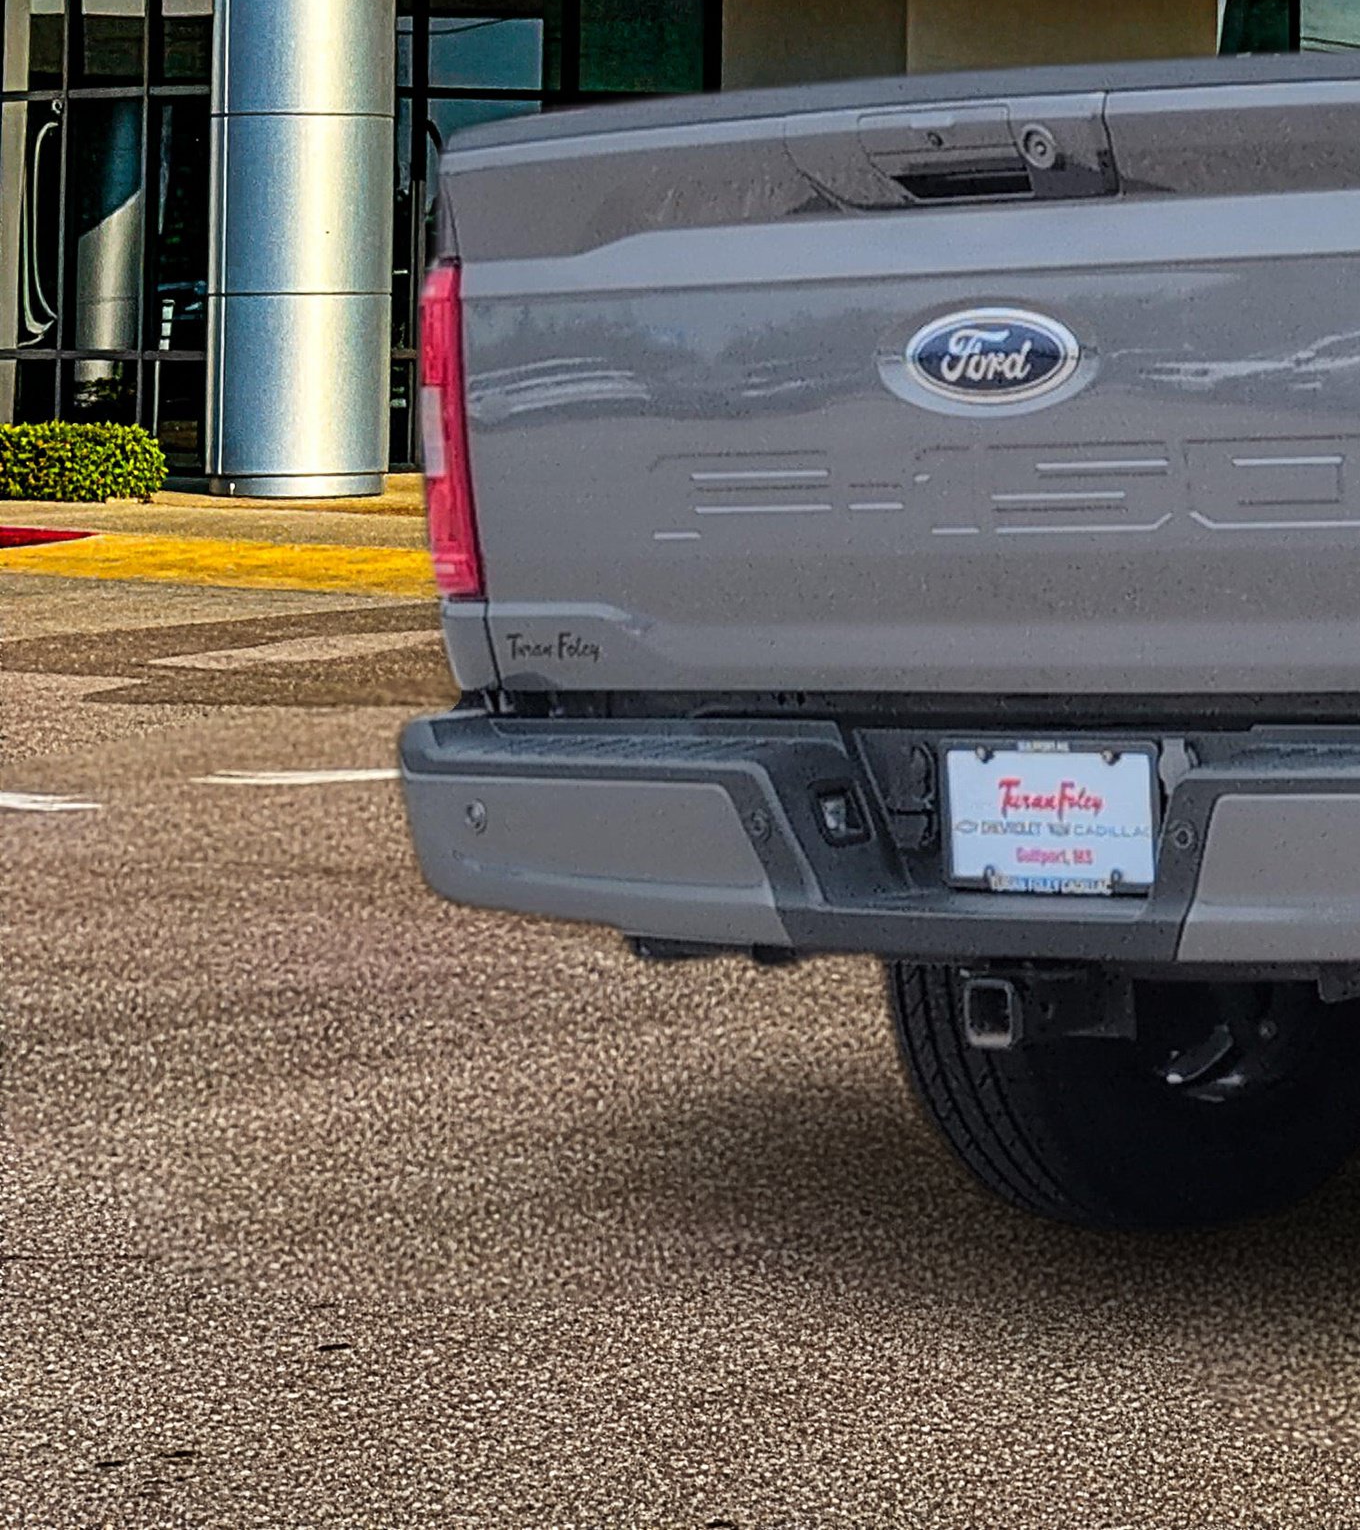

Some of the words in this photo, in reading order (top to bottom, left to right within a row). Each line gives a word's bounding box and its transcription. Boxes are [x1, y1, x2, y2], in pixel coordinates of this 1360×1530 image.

[940, 328, 1033, 382] Ford
[558, 631, 600, 663] Foley
[997, 777, 1056, 817] Turan
[1057, 780, 1103, 821] Foley
